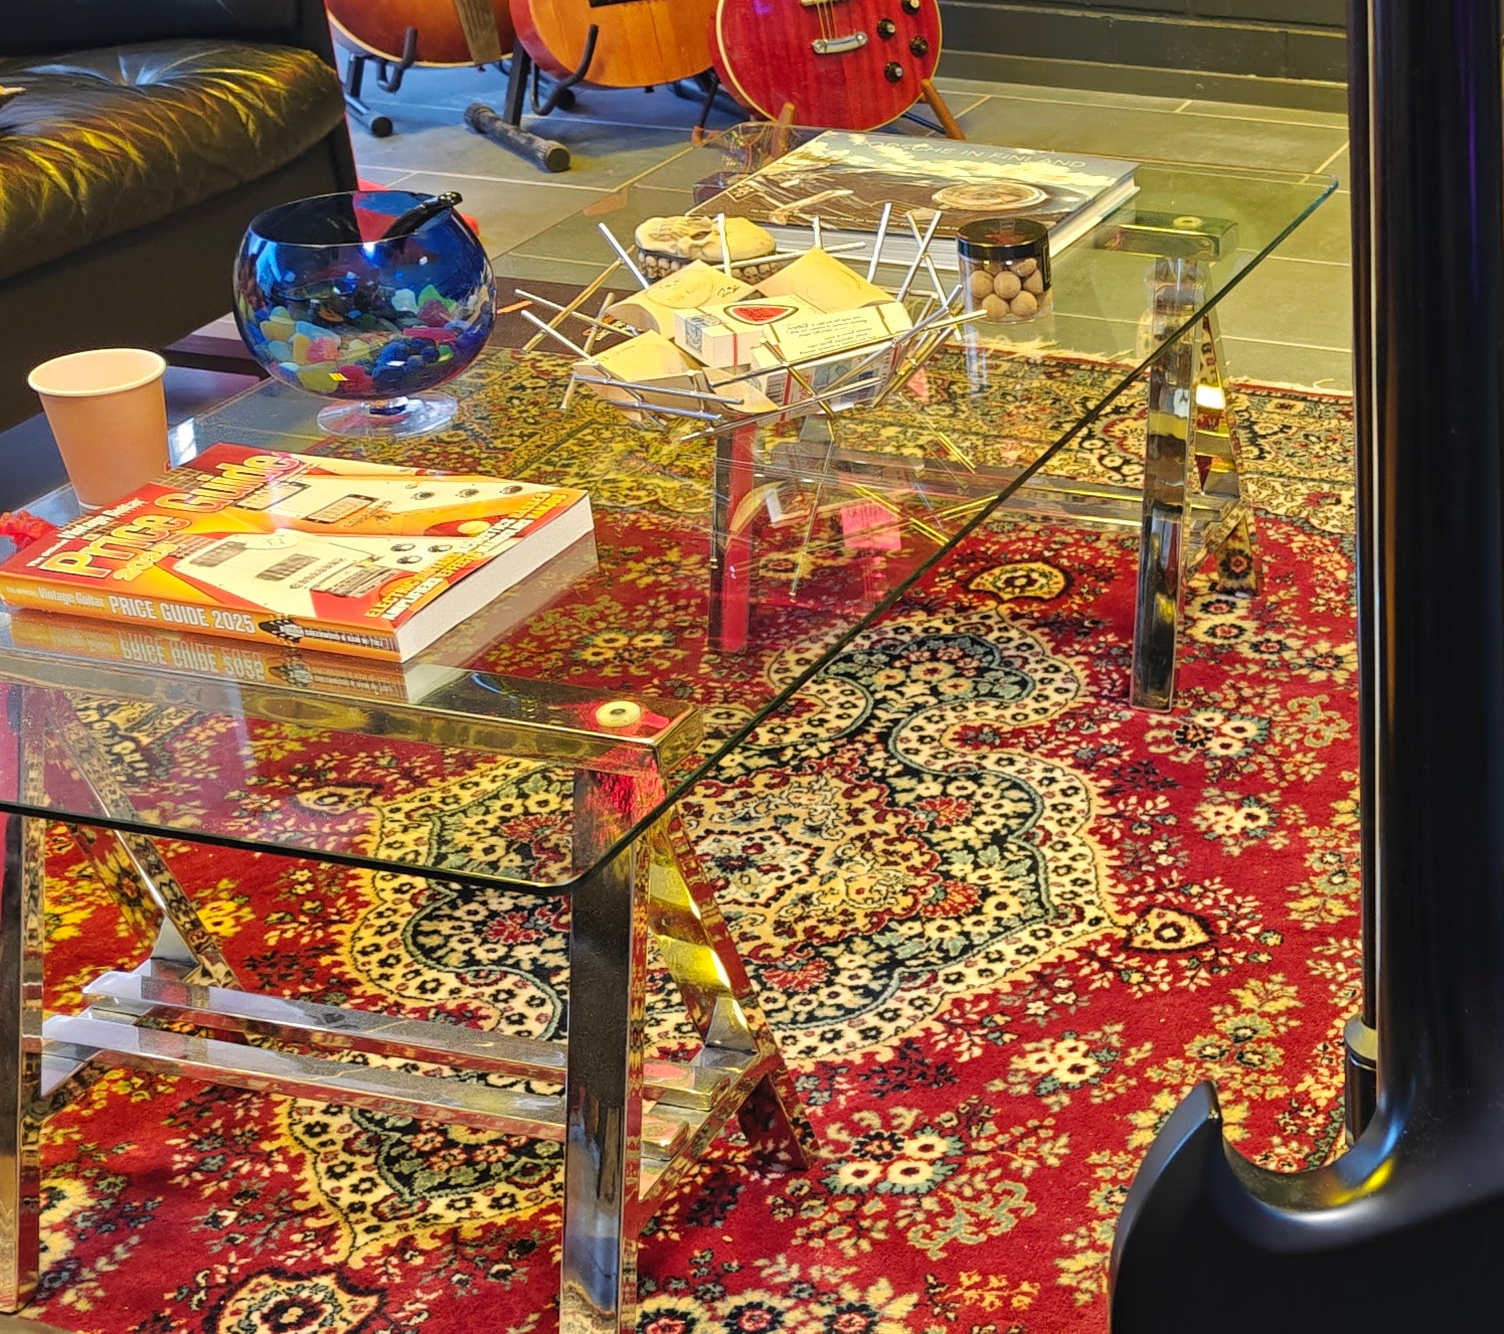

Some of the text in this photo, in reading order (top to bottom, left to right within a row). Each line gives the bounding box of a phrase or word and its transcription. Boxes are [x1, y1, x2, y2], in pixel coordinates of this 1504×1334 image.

[960, 148, 985, 158] IN
[990, 152, 1087, 168] FINLAND
[39, 451, 301, 579] Price Guide
[107, 595, 158, 620] PRICE
[159, 602, 210, 627] GUIDE
[211, 610, 256, 634] 2025
